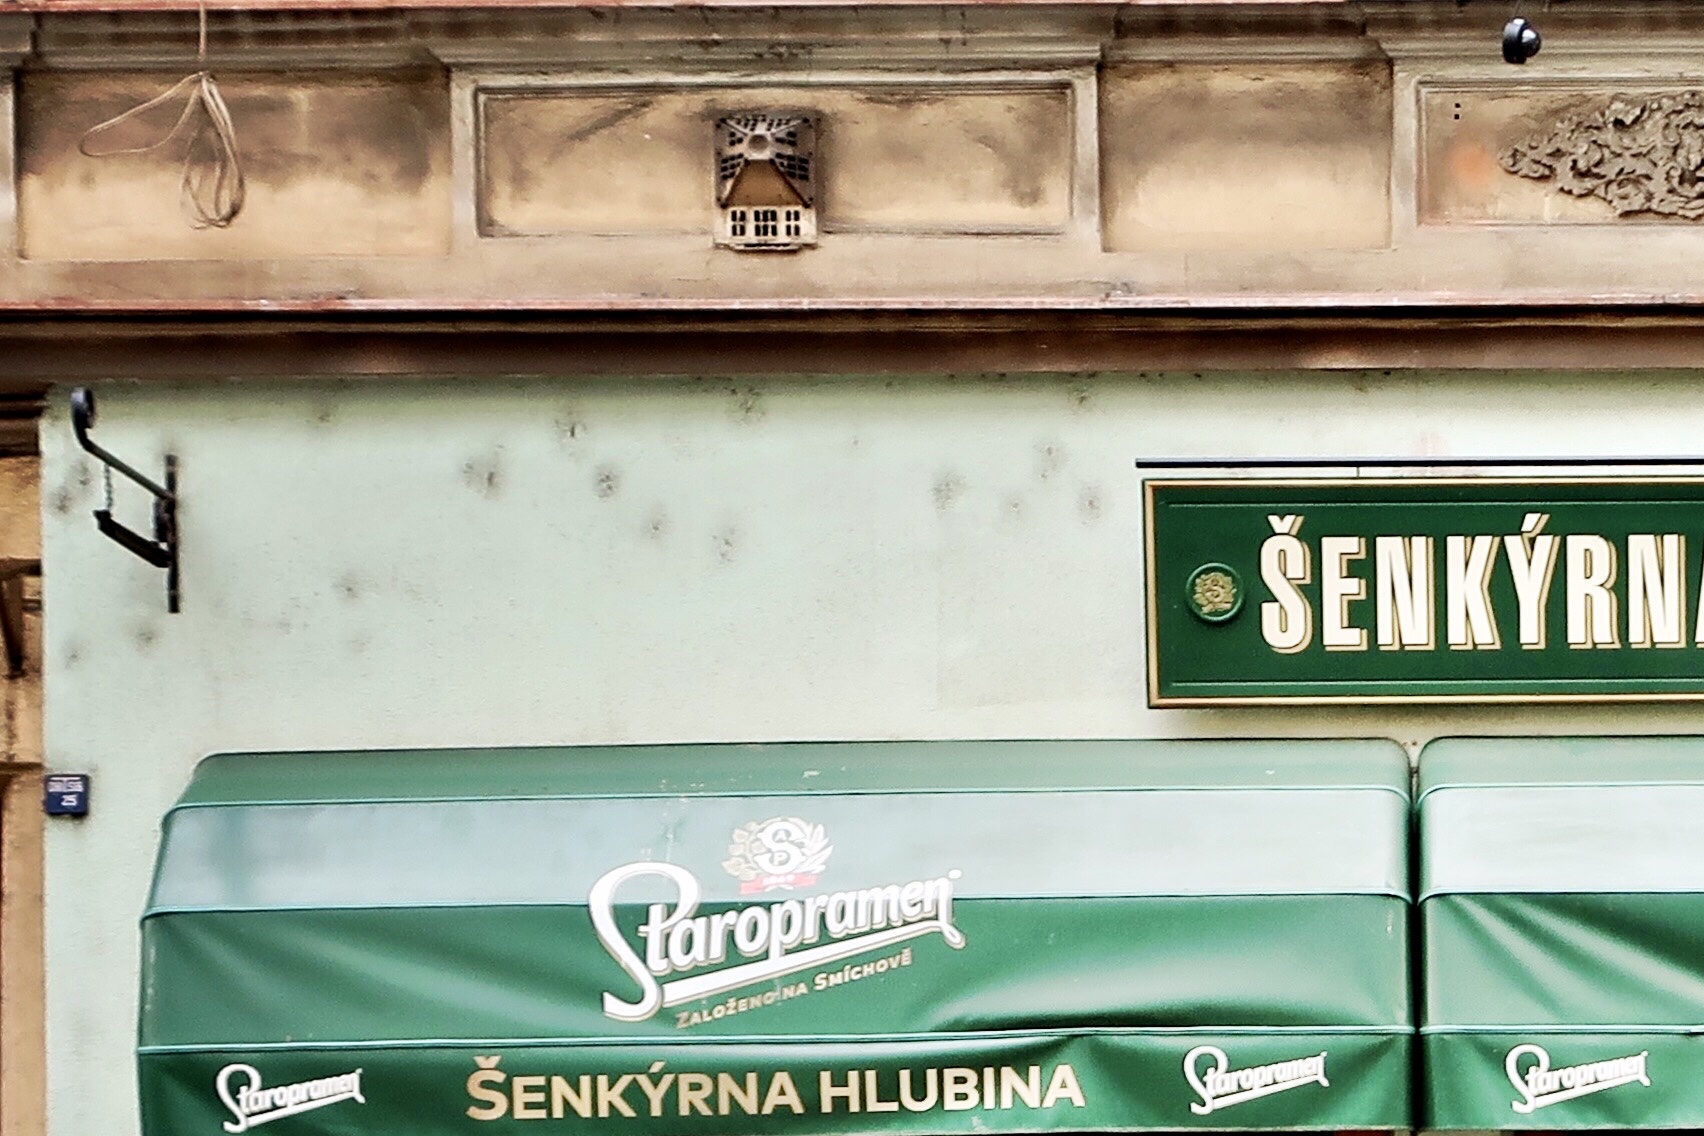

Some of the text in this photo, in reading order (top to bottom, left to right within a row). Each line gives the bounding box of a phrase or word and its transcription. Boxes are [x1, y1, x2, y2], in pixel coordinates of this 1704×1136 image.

[589, 861, 966, 1022] Staropramen
[777, 981, 808, 1003] NA
[216, 1062, 366, 1134] Staropramen
[467, 1056, 1085, 1121] ŠENKÝRNA HLUBINA
[1183, 1045, 1331, 1115] Staropramen
[1505, 1043, 1651, 1114] Staropramen
